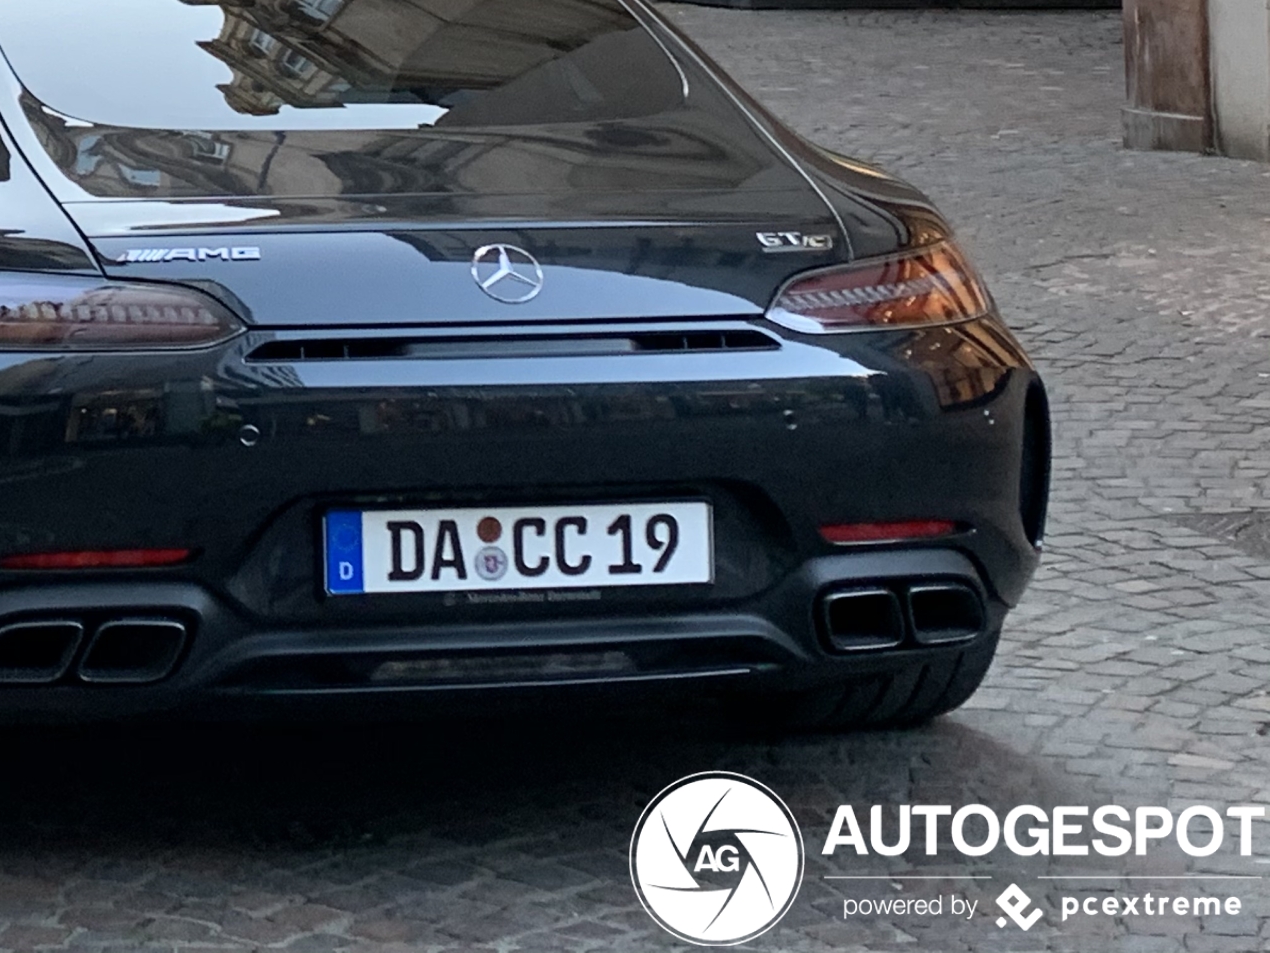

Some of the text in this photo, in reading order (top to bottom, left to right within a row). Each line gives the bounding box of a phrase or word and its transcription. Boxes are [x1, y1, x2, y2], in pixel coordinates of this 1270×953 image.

[161, 247, 261, 262] AMG
[386, 513, 680, 581] DA CC 19
[339, 561, 354, 581] D
